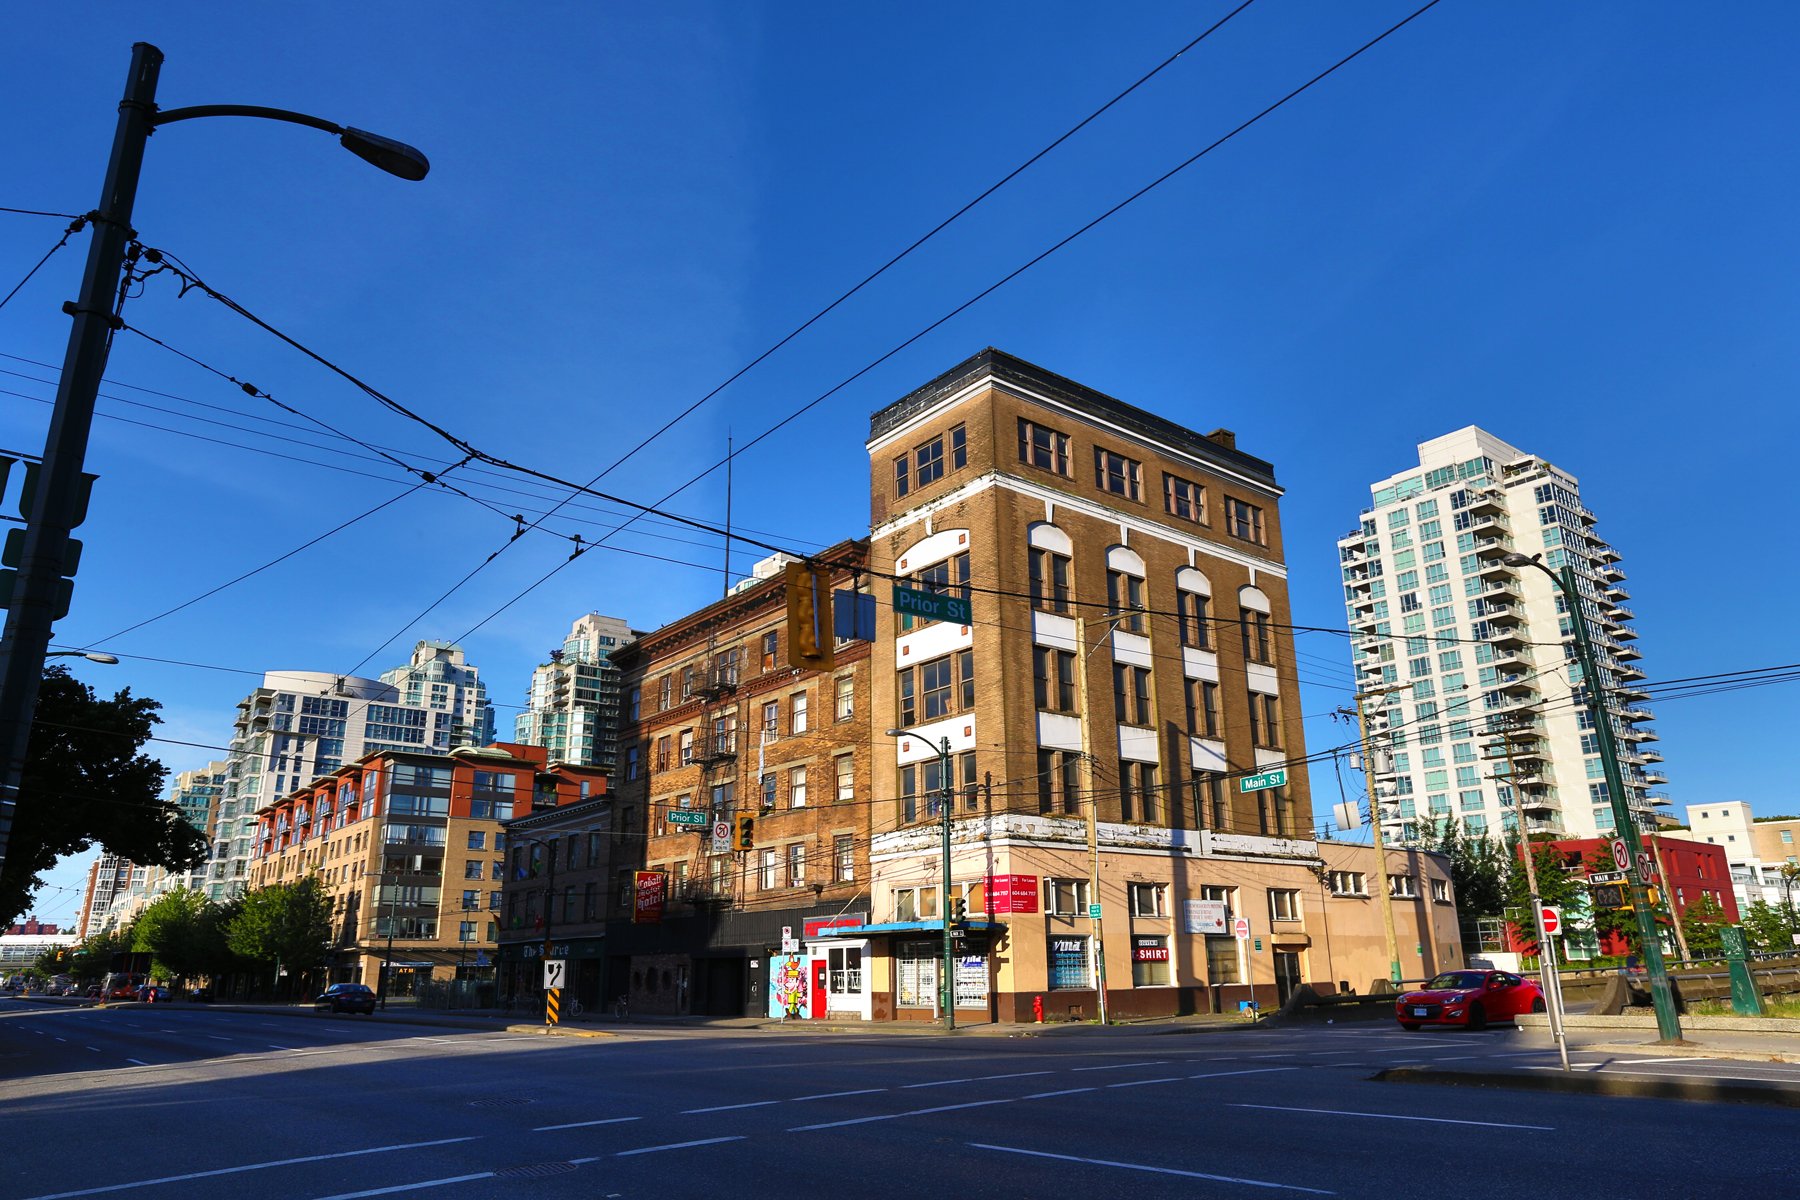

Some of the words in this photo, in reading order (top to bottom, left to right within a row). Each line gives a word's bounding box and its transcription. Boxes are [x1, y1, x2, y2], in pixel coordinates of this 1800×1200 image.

[900, 591, 939, 613] Prior
[947, 601, 966, 620] St
[1245, 778, 1266, 789] Main
[1270, 774, 1281, 784] St
[671, 813, 691, 822] Prior
[693, 814, 704, 823] St
[637, 874, 662, 889] Cobalt
[637, 892, 661, 911] Hotel
[539, 944, 569, 956] Surce
